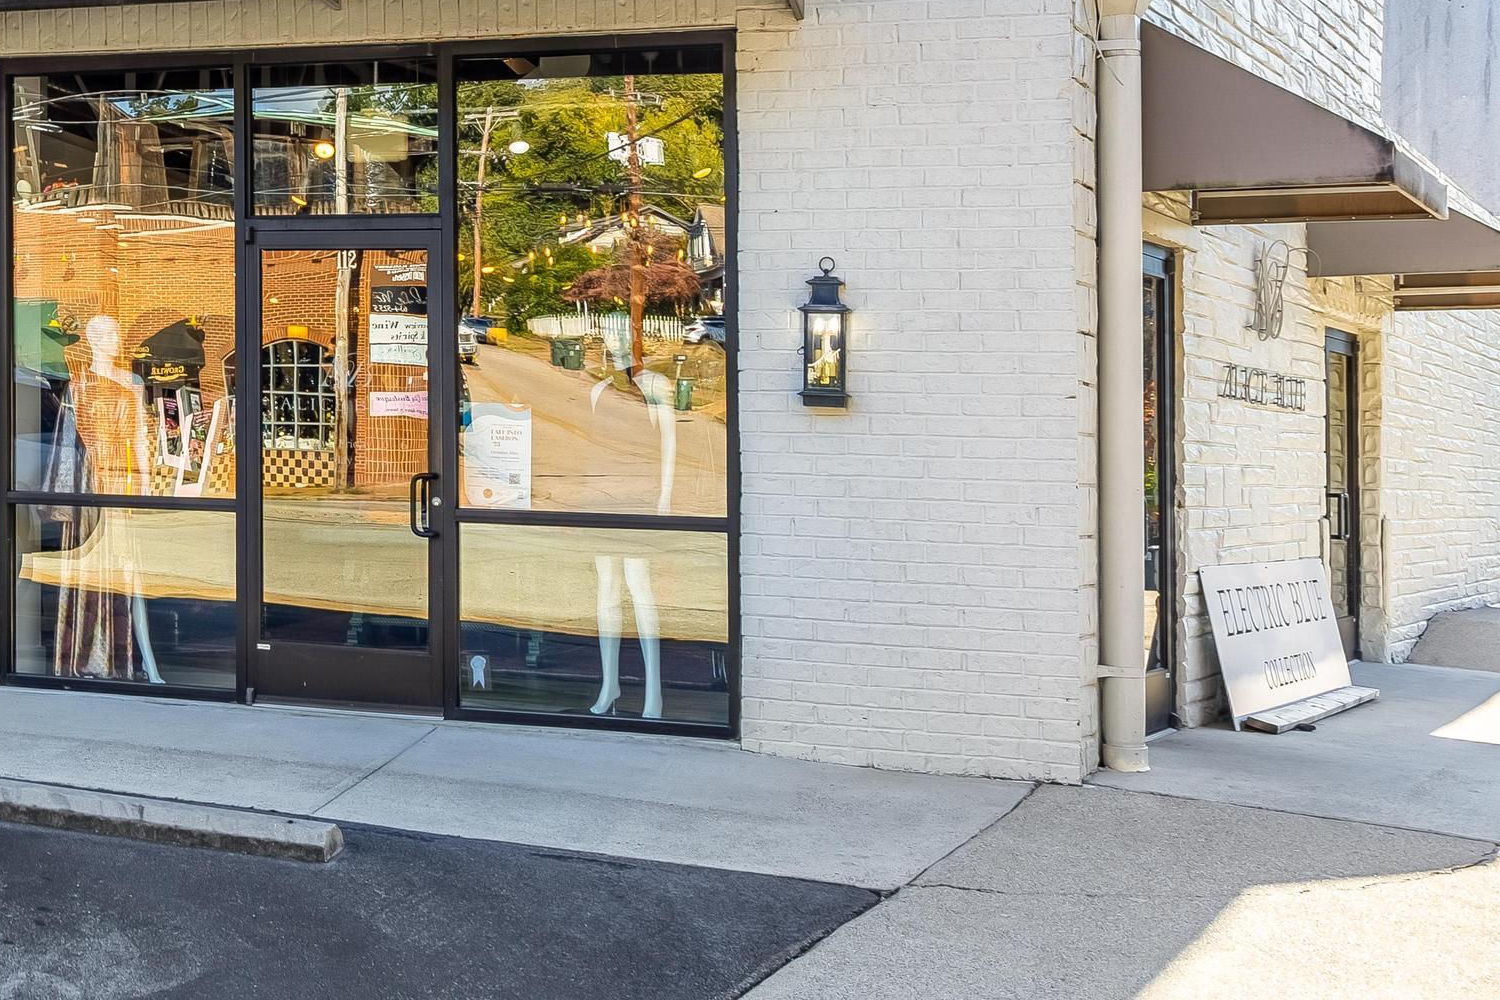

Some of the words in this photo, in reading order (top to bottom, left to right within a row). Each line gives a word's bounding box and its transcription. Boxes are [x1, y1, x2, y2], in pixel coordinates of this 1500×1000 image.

[337, 250, 357, 269] 112
[281, 396, 344, 412] ALIC
[1217, 583, 1291, 637] ELECTRIC
[1287, 579, 1327, 625] BLUE
[1263, 651, 1318, 690] COLLECTION
